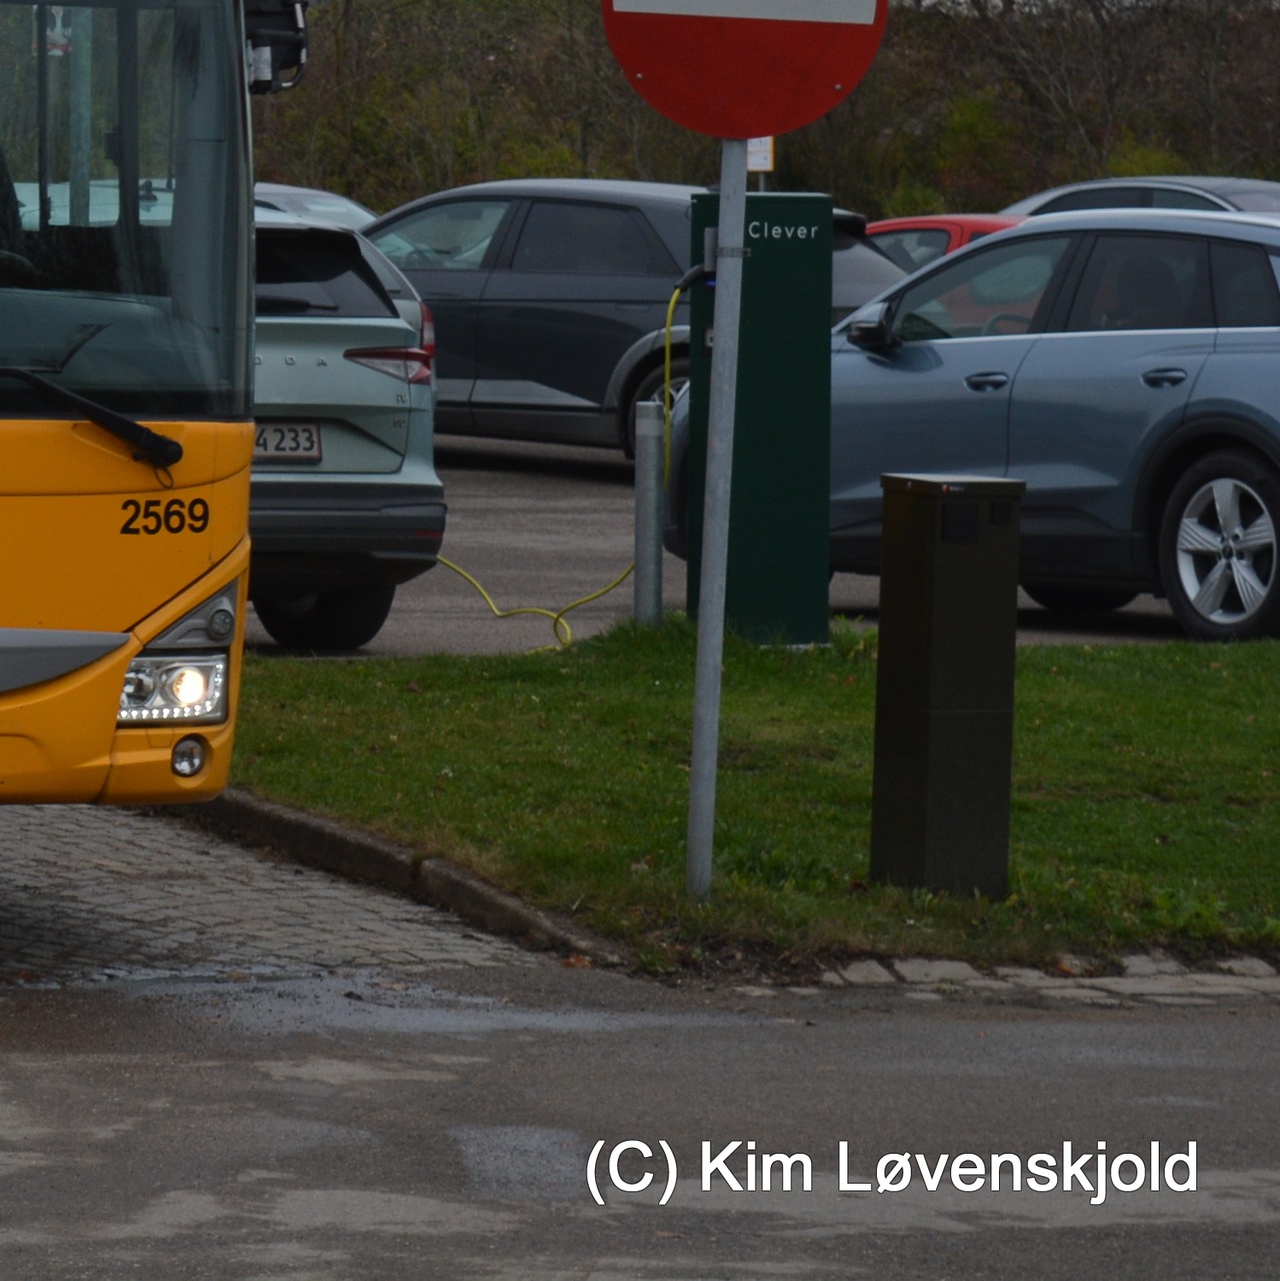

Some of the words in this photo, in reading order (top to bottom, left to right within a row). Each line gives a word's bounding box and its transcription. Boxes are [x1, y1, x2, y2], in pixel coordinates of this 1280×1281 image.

[748, 221, 818, 239] Clever
[274, 428, 315, 451] 233
[119, 498, 209, 535] 2569
